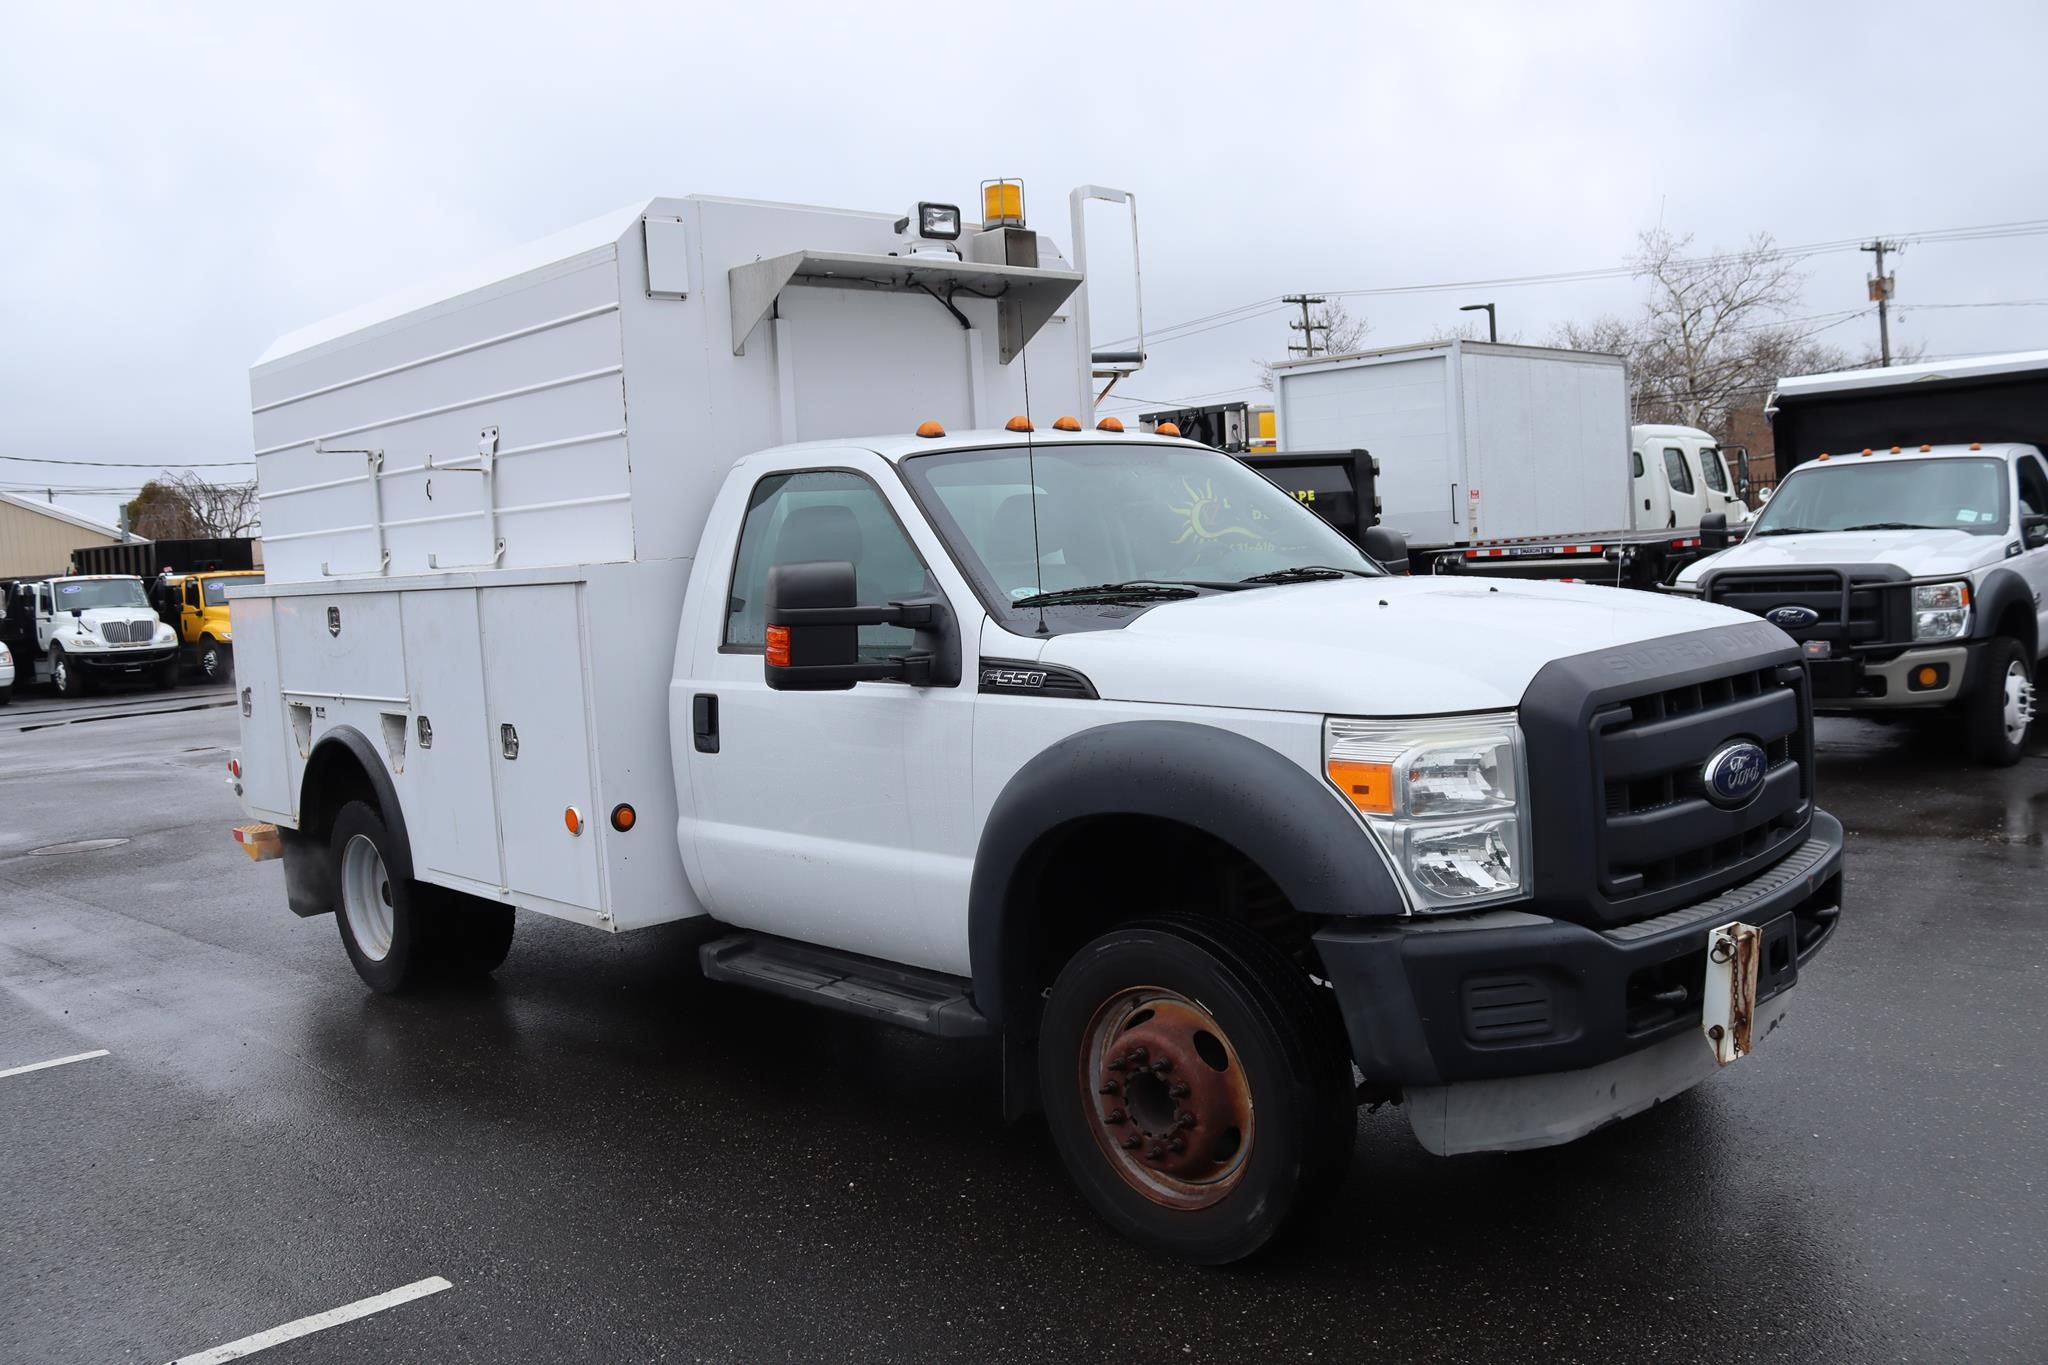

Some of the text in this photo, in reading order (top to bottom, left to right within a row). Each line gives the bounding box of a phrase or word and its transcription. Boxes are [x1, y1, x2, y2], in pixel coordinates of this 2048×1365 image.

[1776, 609, 1805, 623] Ford
[1600, 624, 1776, 674] SUPER DUTY
[1728, 754, 1760, 790] Ford
